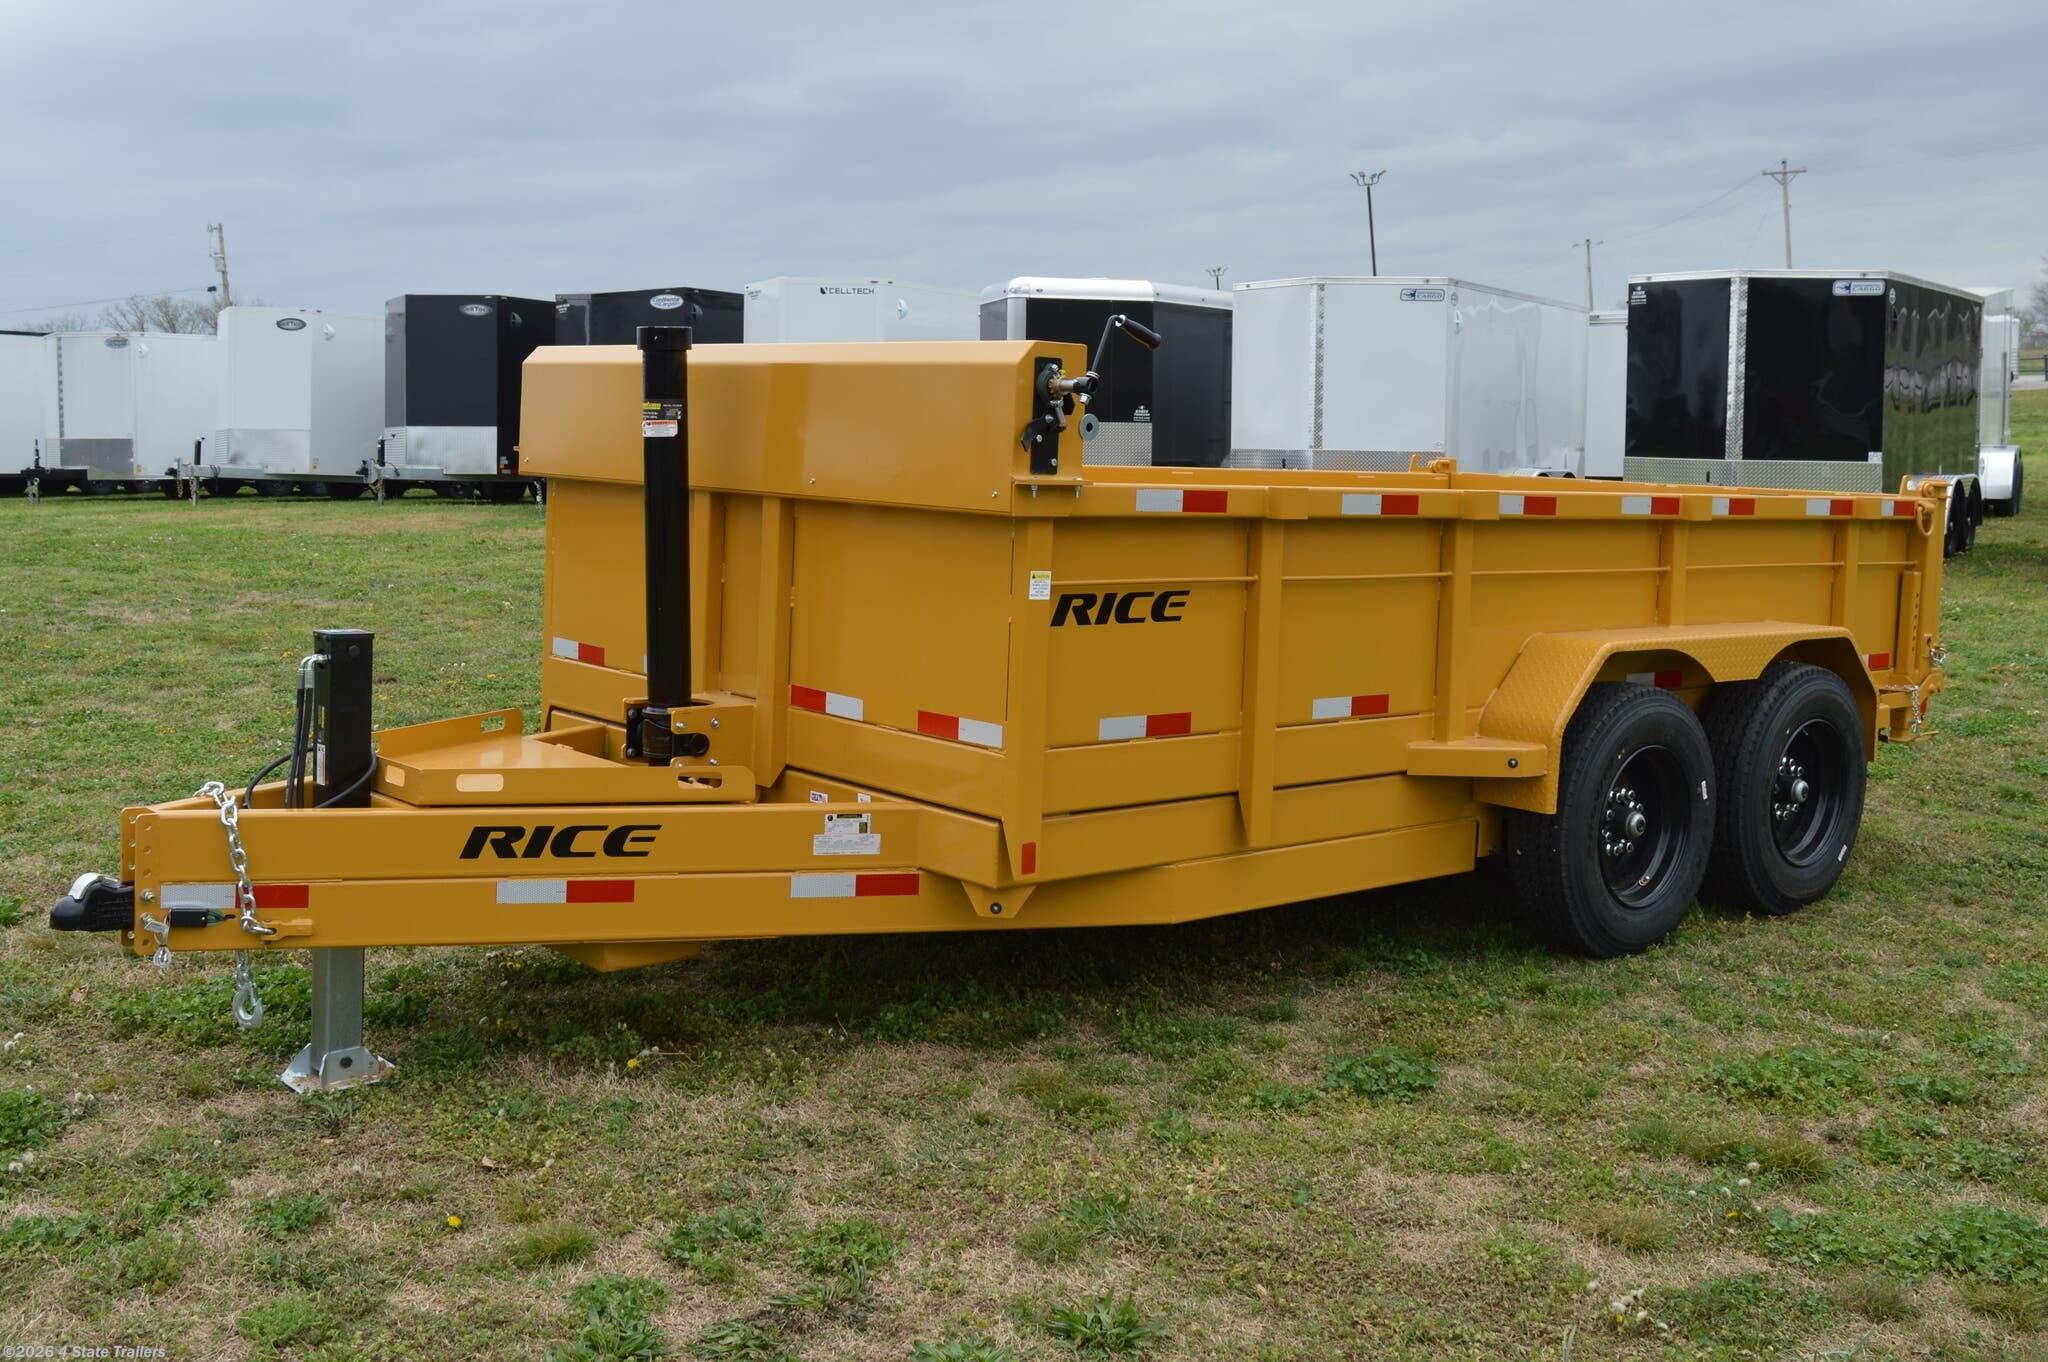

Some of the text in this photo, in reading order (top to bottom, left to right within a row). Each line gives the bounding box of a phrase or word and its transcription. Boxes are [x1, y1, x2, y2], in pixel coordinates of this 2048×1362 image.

[828, 287, 875, 295] CELLTECH
[1050, 590, 1191, 627] RICE
[459, 825, 662, 859] RICE
